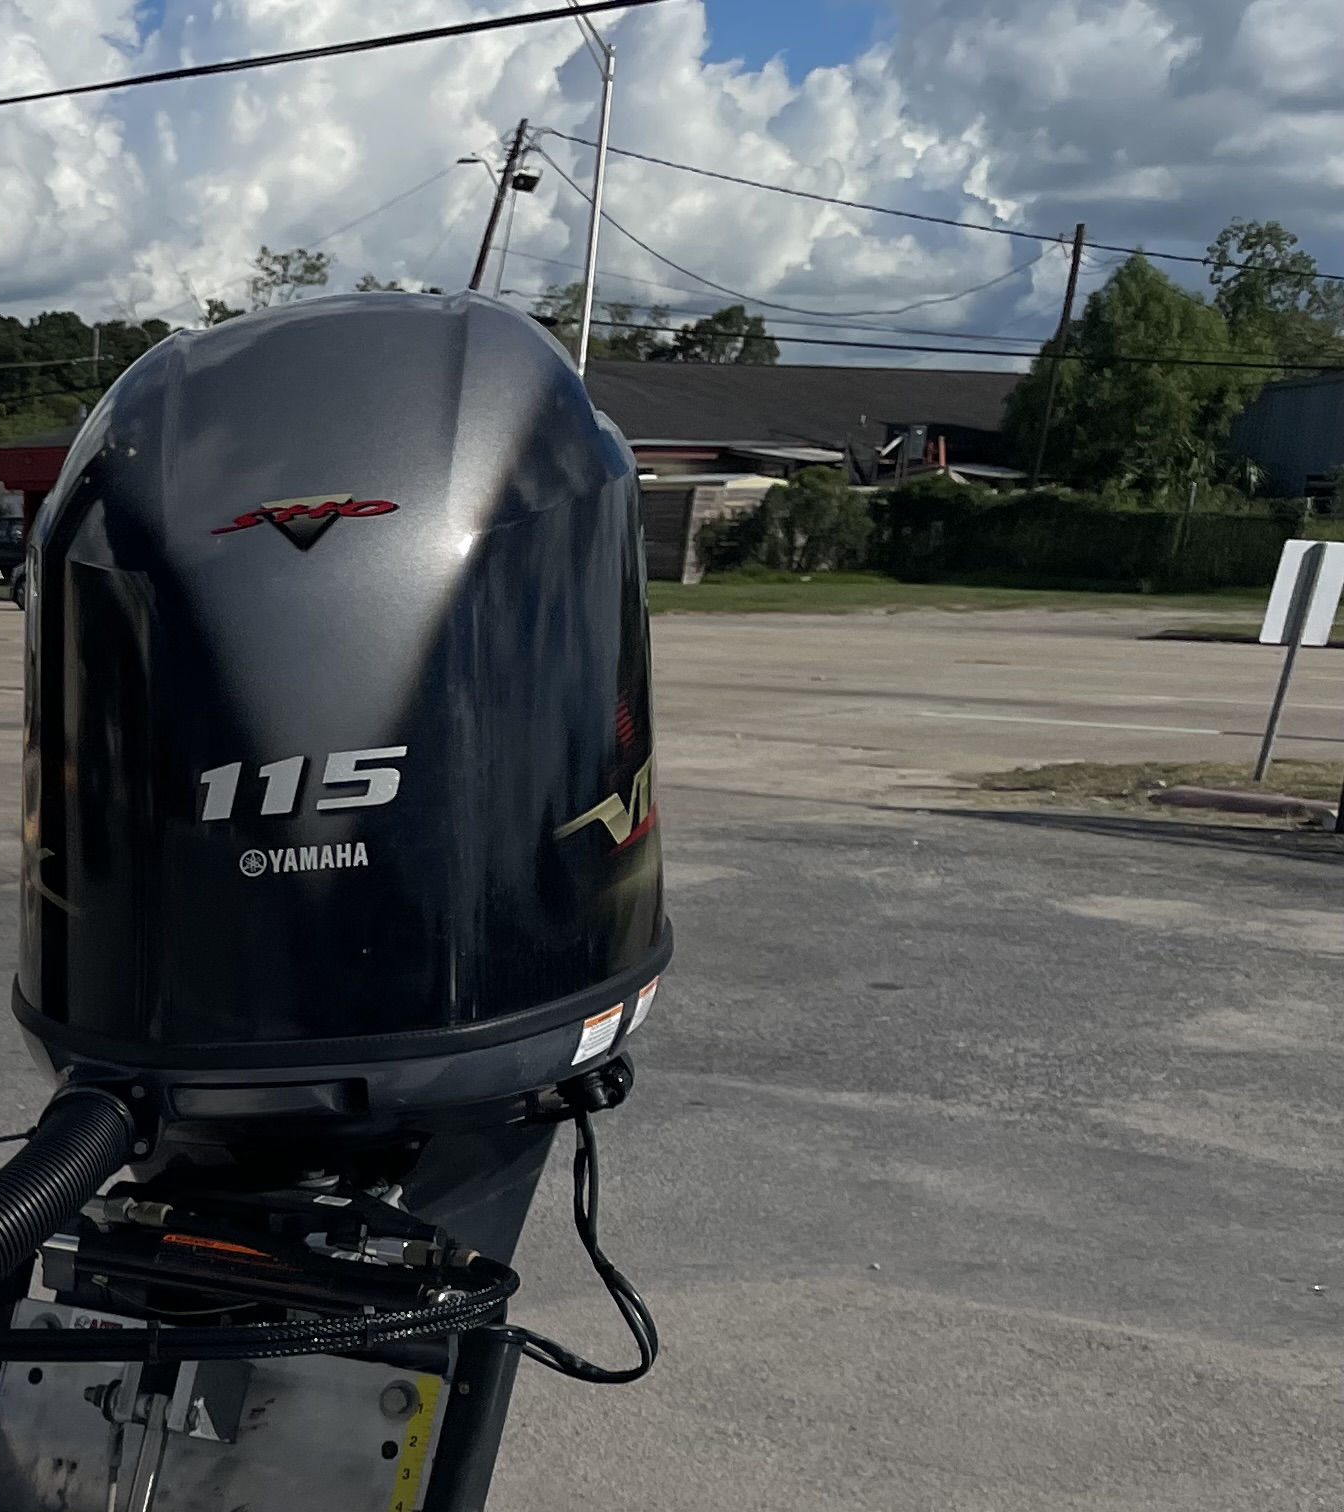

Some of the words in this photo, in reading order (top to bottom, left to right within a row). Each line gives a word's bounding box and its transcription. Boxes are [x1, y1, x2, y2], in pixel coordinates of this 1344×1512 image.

[200, 745, 408, 821] 115
[268, 842, 369, 874] YAMAHA
[409, 1435, 418, 1448] 2
[402, 1468, 410, 1480] 3
[395, 1501, 403, 1512] 4
